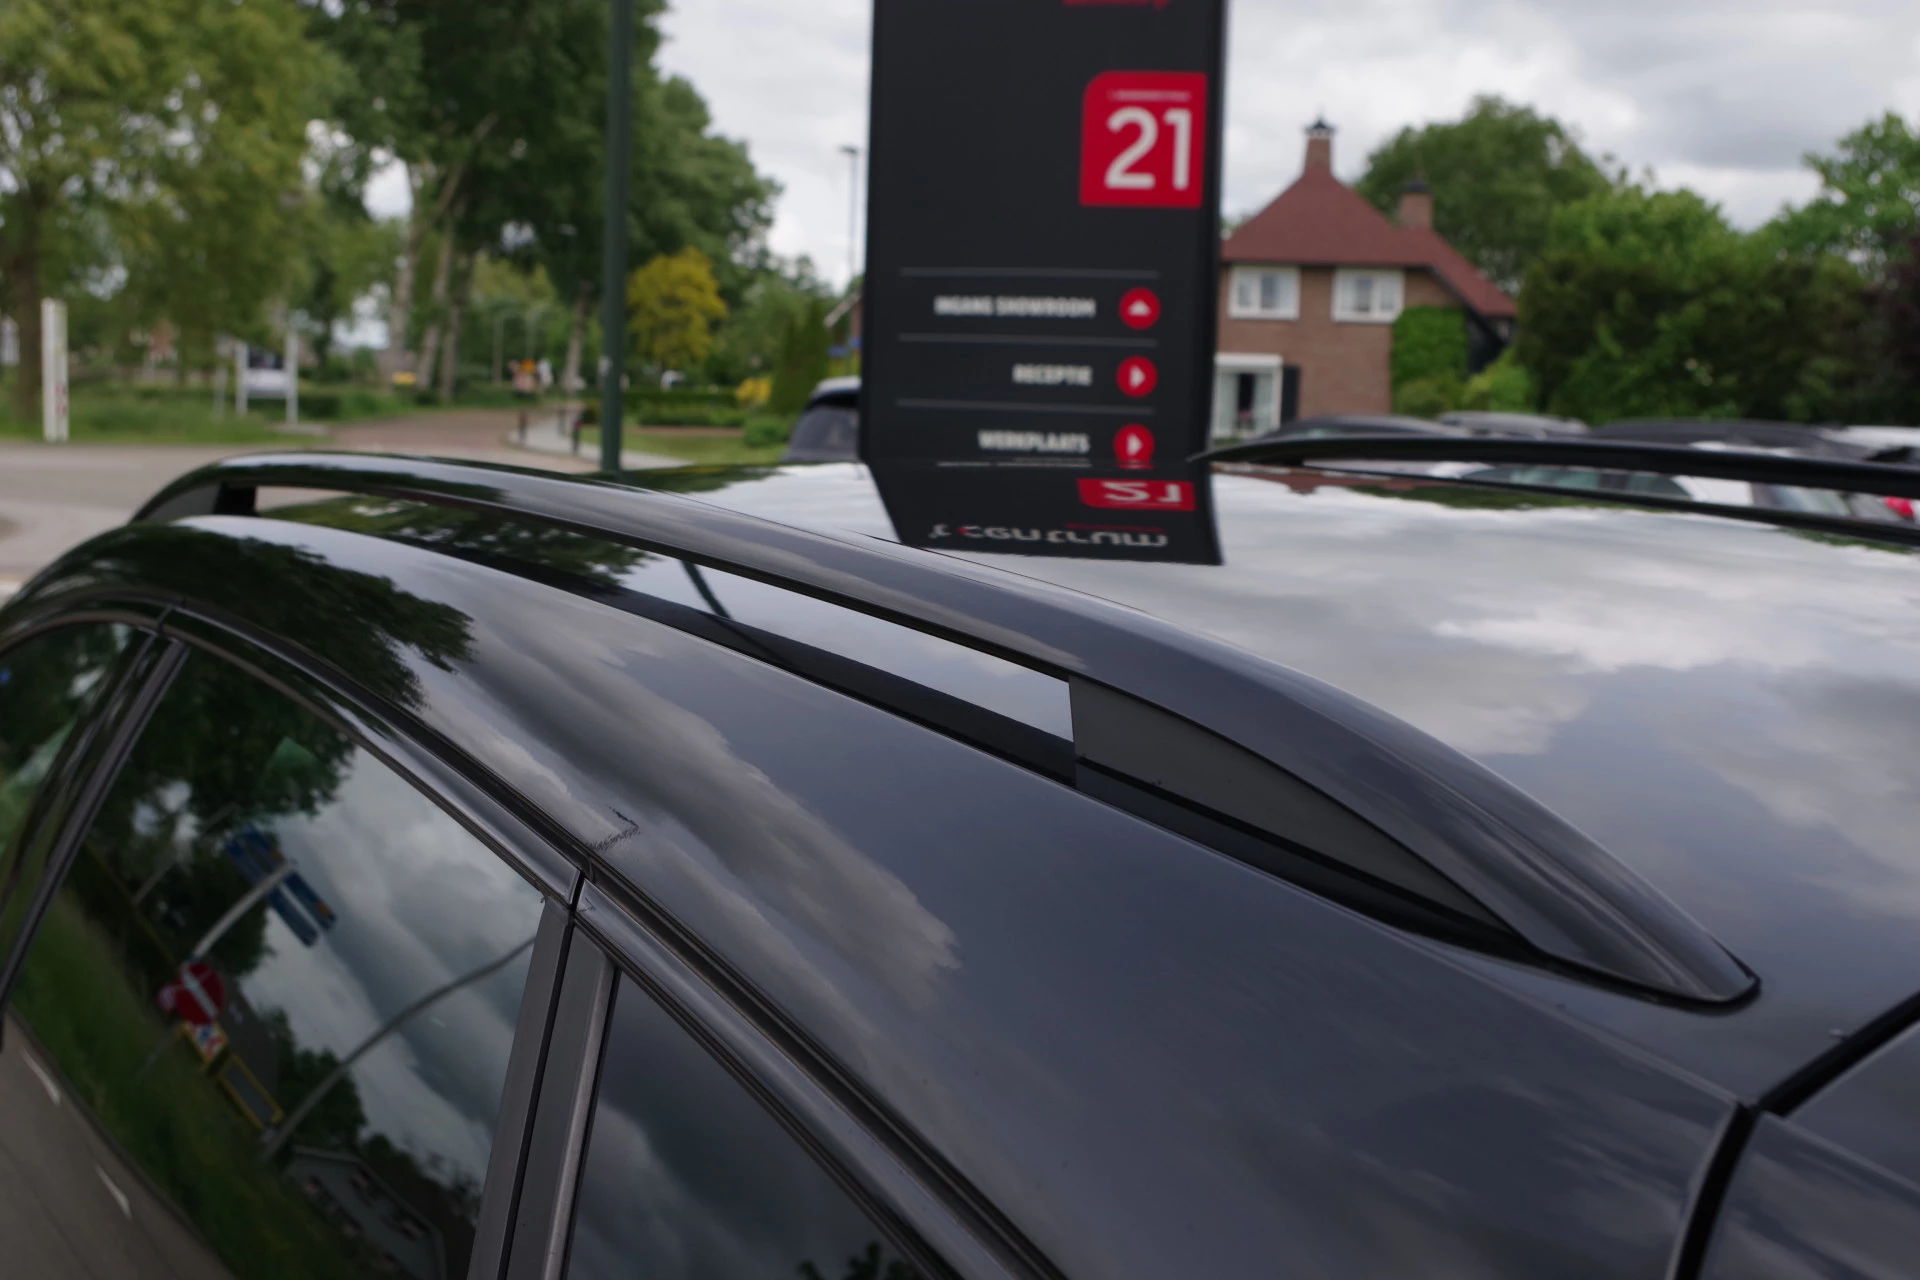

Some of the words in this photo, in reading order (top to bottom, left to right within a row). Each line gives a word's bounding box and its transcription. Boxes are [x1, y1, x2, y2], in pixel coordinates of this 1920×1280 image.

[1104, 105, 1192, 190] 21
[995, 295, 1097, 318] SHOWROOM
[1011, 364, 1093, 386] RECEPTIE
[977, 429, 1090, 453] WERKPLAATS
